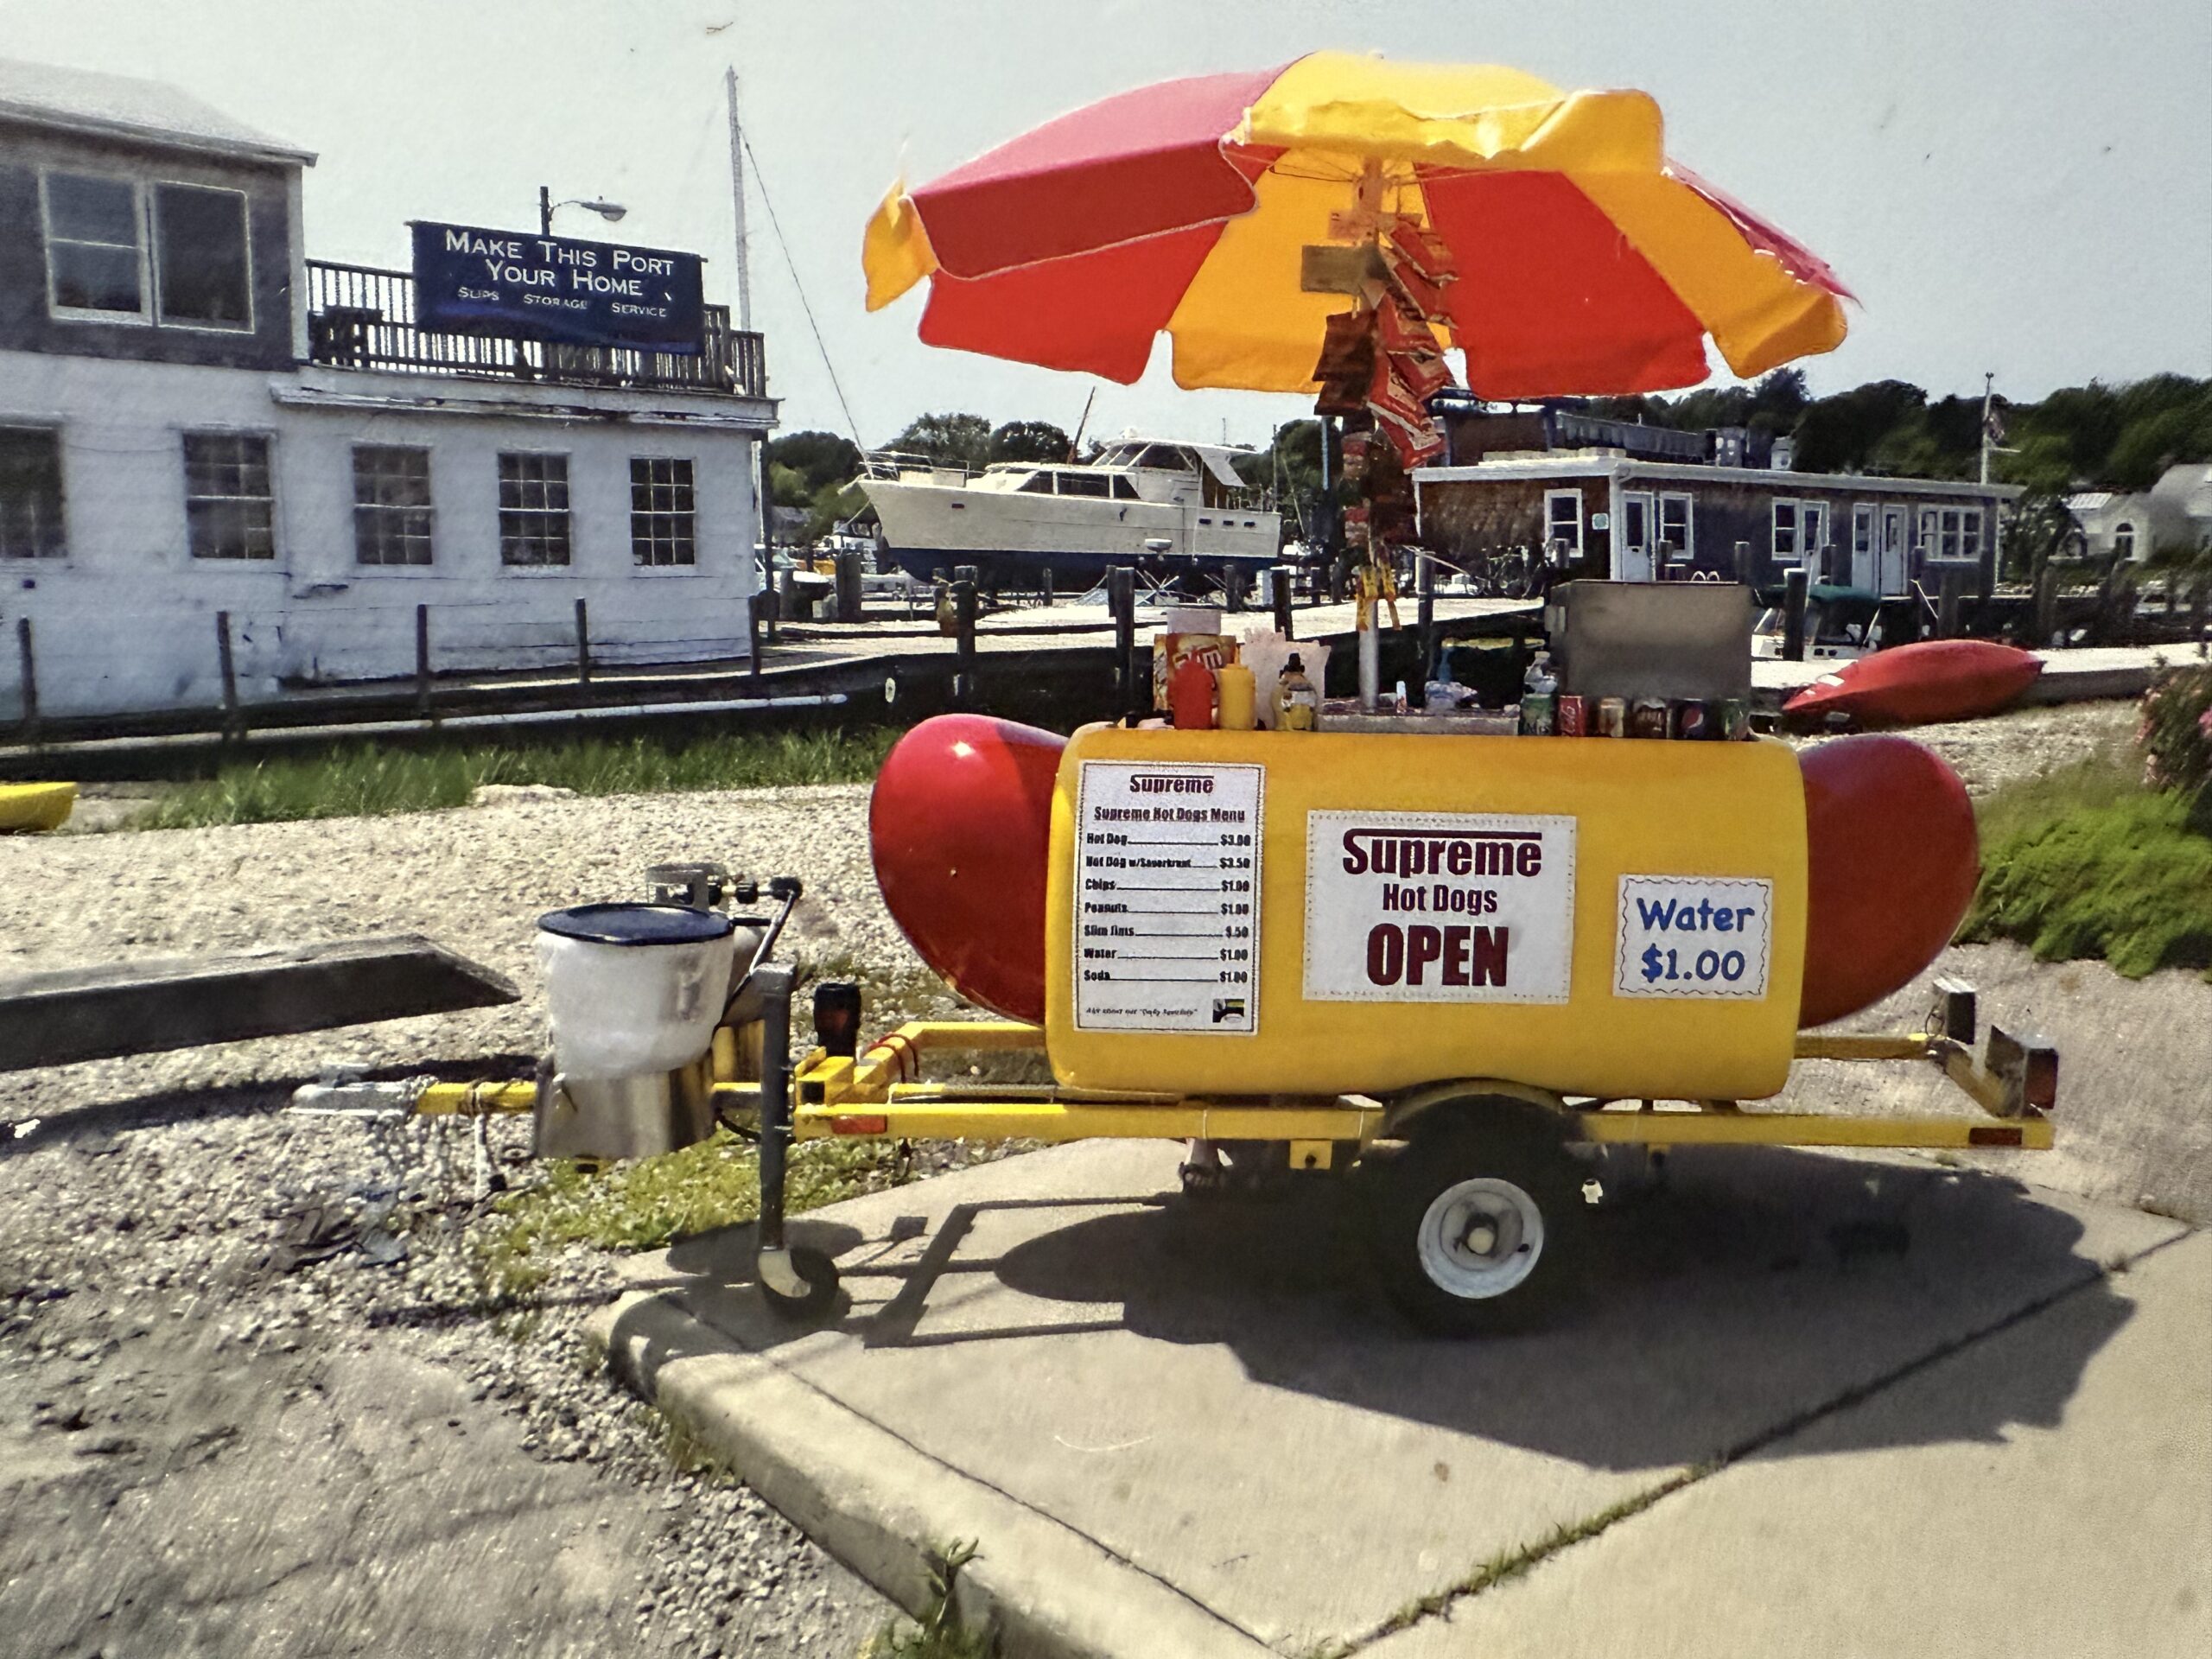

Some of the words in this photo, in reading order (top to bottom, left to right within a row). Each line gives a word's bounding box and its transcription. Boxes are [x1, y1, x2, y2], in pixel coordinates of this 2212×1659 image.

[1129, 774, 1215, 794] Supreme
[1094, 805, 1151, 822] Supreme
[1154, 806, 1174, 822] Hot
[1177, 808, 1208, 823] Dogs
[1211, 808, 1245, 823] Menu
[1087, 833, 1105, 844] Hot
[1107, 833, 1128, 846] Dog
[1220, 835, 1251, 846] $3.00
[1086, 855, 1104, 868] Hot
[1106, 856, 1127, 868] Dog
[1219, 857, 1250, 869] $3.50
[1343, 828, 1542, 878] Supreme
[1085, 879, 1116, 891] Chips
[1221, 880, 1249, 892] $1.00
[1084, 902, 1128, 913] Peanuts
[1220, 903, 1249, 915] $1.00
[1382, 883, 1427, 912] Hot
[1433, 884, 1497, 916] Dogs
[1637, 897, 1756, 932] Water
[1084, 948, 1117, 959] Water
[1219, 949, 1249, 961] $1.00
[1367, 923, 1510, 987] OPEN
[1641, 943, 1746, 983] $1.00
[1084, 969, 1111, 982] Soda
[1219, 971, 1248, 983] $1.00
